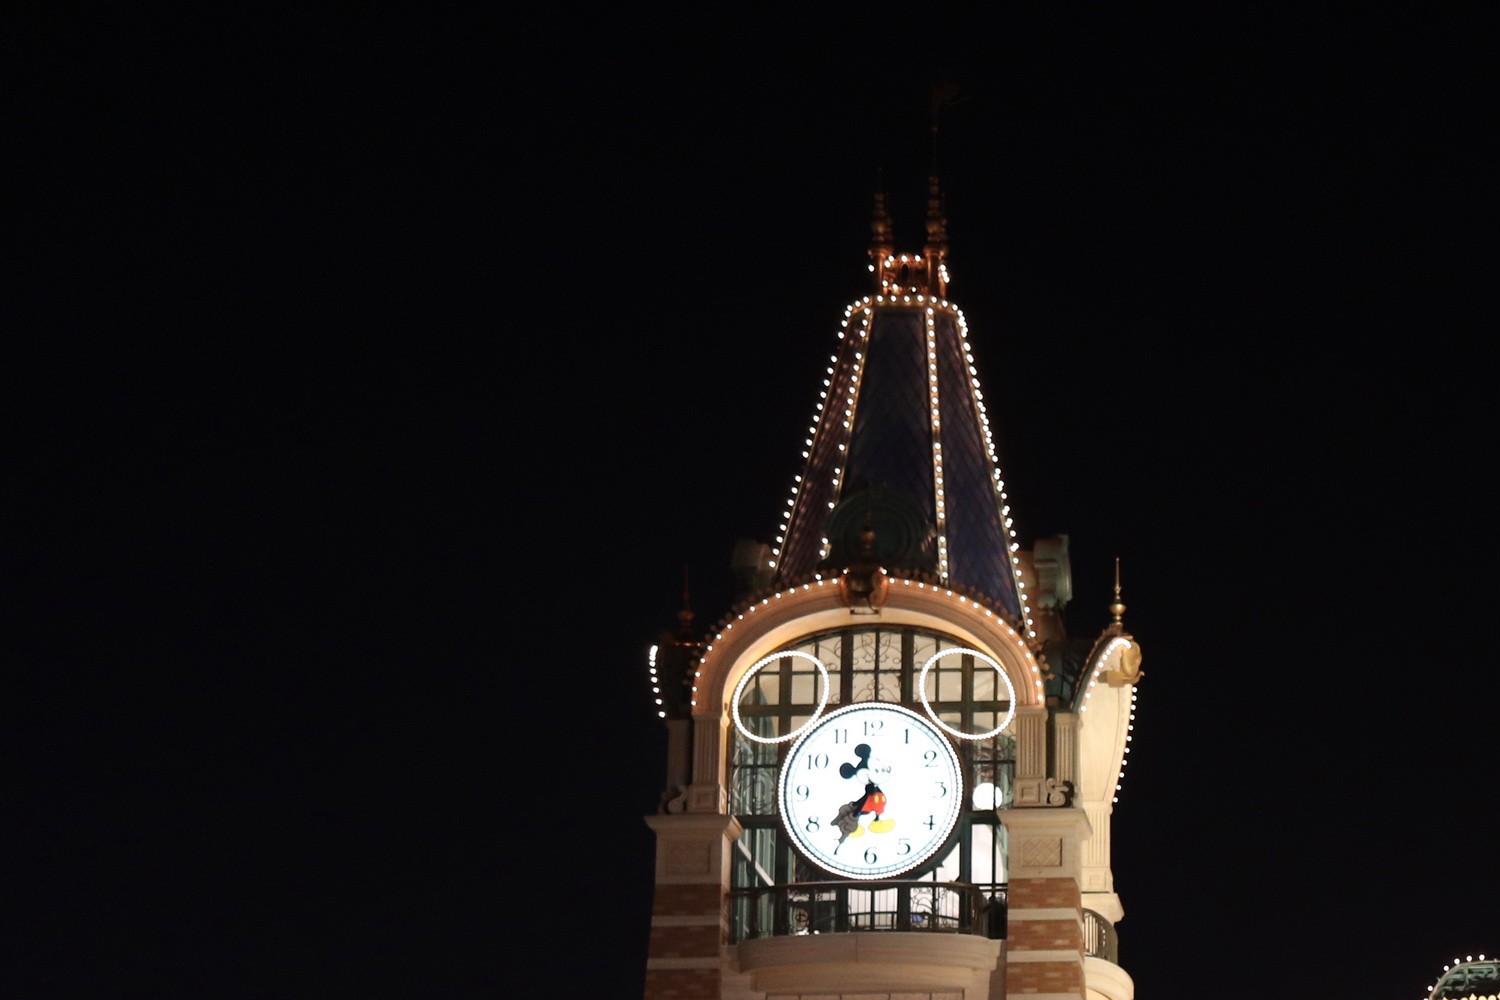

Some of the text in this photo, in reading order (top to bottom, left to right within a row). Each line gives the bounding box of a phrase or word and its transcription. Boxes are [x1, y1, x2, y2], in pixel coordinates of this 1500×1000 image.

[834, 728, 848, 744] 11
[863, 719, 884, 736] 12
[904, 728, 909, 744] 1
[807, 753, 829, 770] 10
[923, 750, 937, 767] 2
[796, 784, 810, 802] 9
[933, 781, 947, 798] 3
[805, 815, 820, 833] 8
[923, 814, 936, 831] 4
[864, 846, 877, 865] 6
[897, 838, 911, 856] 5
